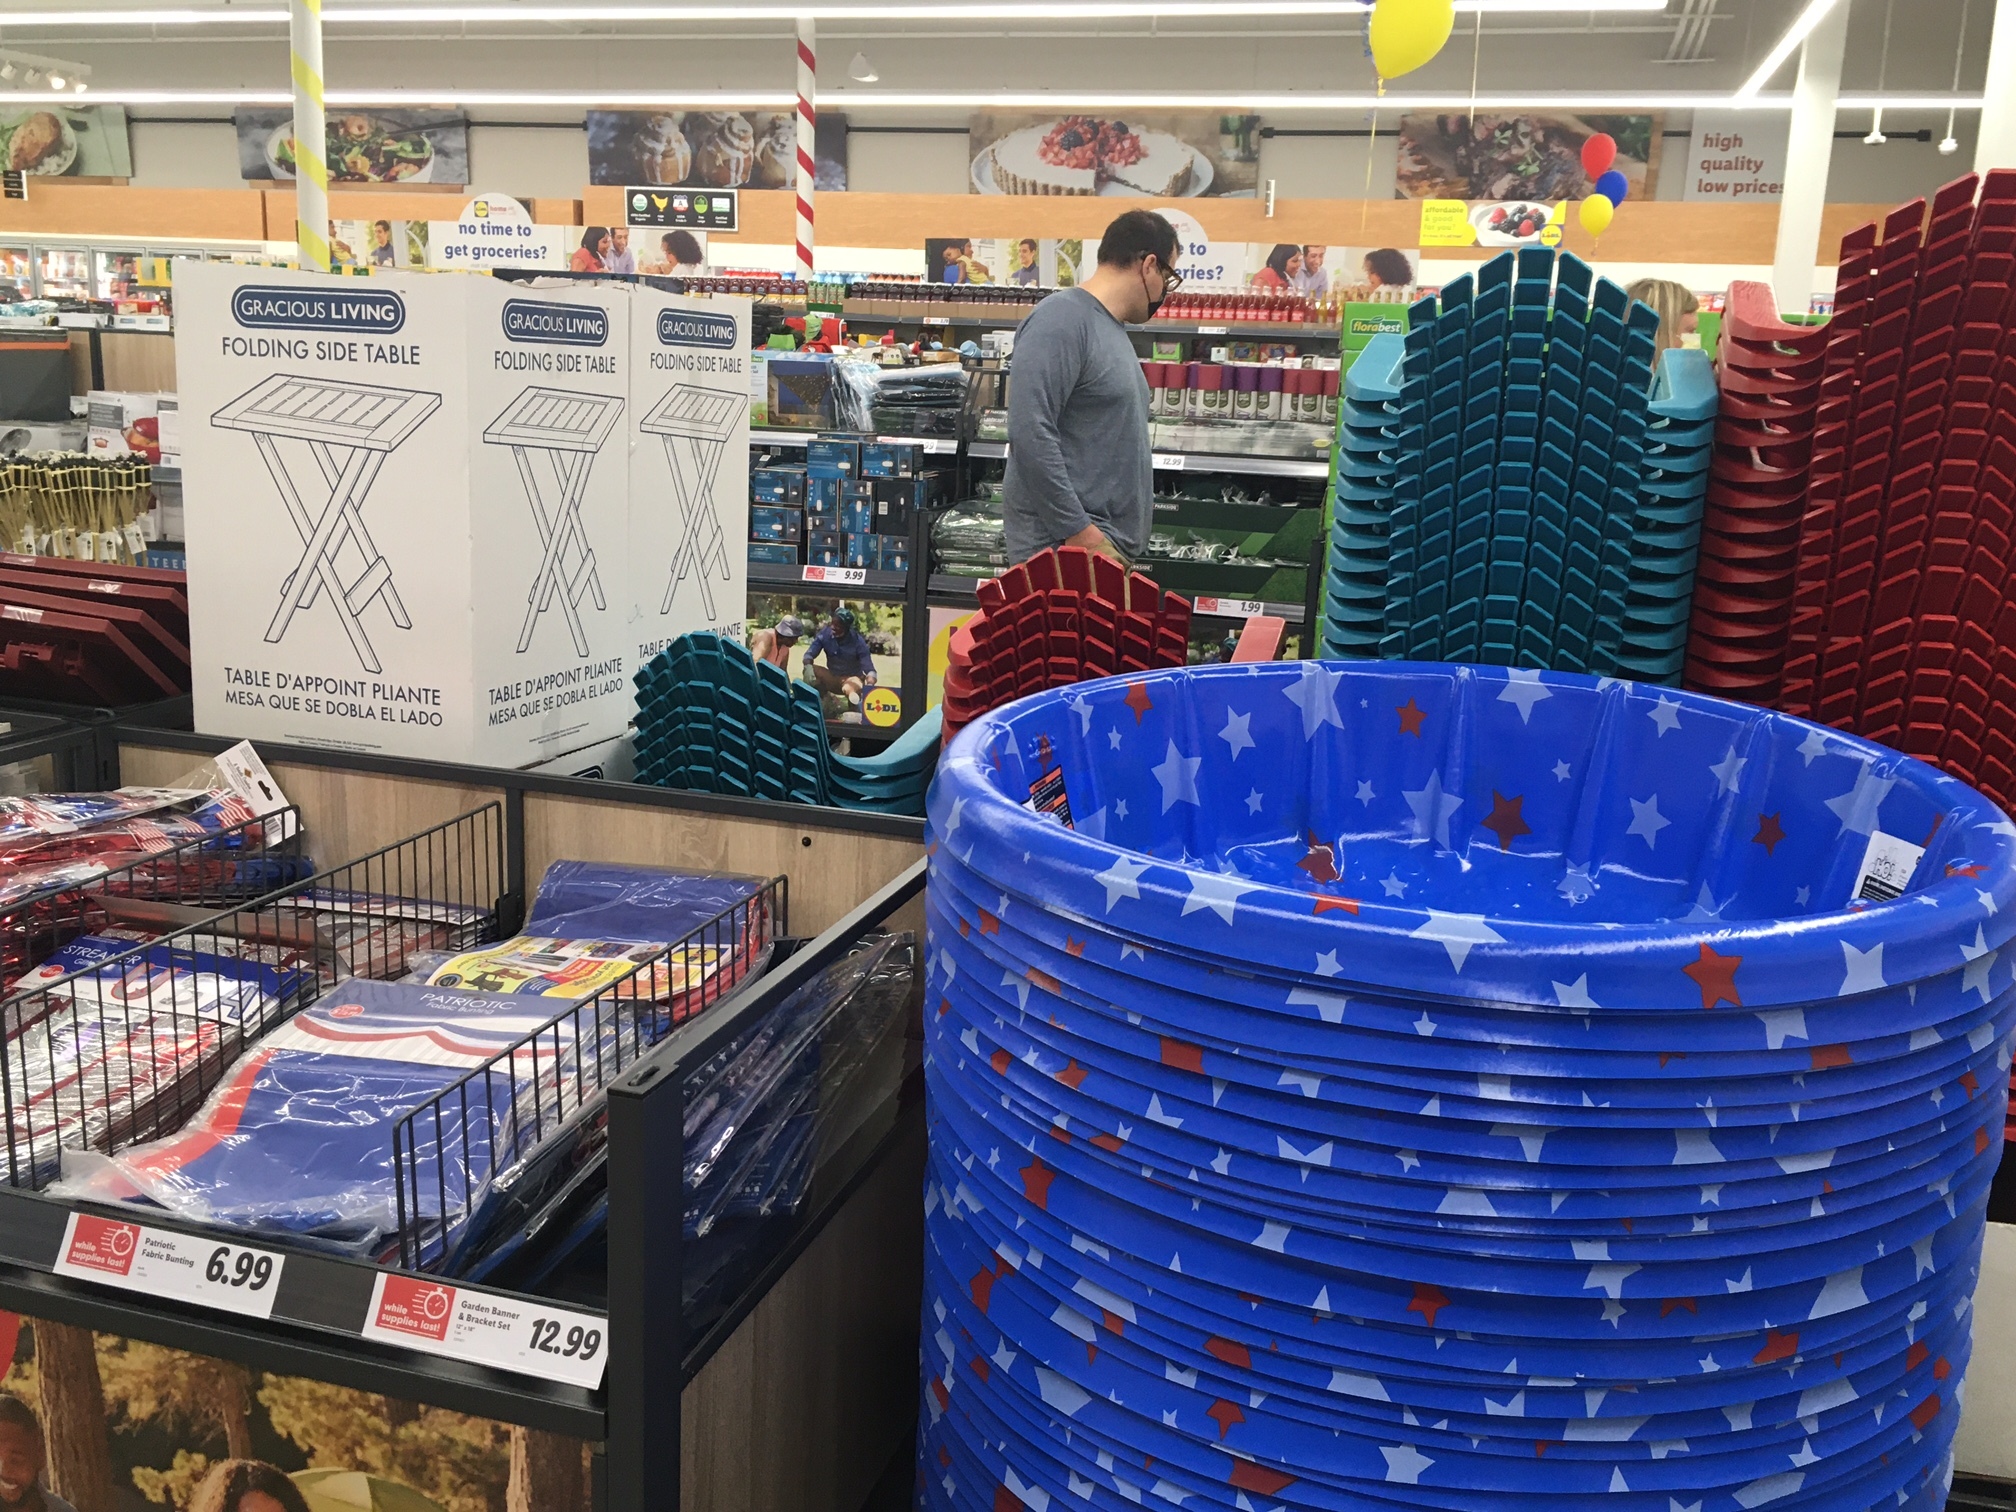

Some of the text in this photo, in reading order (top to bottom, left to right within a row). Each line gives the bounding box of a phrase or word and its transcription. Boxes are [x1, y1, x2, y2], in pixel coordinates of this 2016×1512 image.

[1702, 132, 1744, 152] high
[1700, 155, 1764, 174] quality
[1697, 178, 1784, 197] low prices
[1424, 206, 1464, 214] affordable
[458, 220, 532, 237] no time to
[444, 243, 547, 261] get groceries?
[1189, 242, 1207, 256] to
[1175, 264, 1224, 281] eries?
[241, 299, 395, 321] GRACIOUS LIVING
[508, 313, 603, 335] GRACIOUS LIVING
[661, 320, 733, 340] GRACIOUS LIVING
[1352, 320, 1401, 333] florabest
[222, 337, 420, 365] FOLDING SIDE TABLE
[494, 350, 616, 374] FOLDING SIDE TABLE
[650, 352, 694, 371] FOLDING
[697, 355, 716, 373] SIDE
[719, 356, 742, 374] TABLE
[1162, 457, 1182, 466] 12.99
[844, 570, 864, 581] 9.99
[1240, 601, 1261, 613] 1.99
[638, 639, 664, 659] TABLE
[224, 667, 441, 706] TABLE D'APPOINT PLIANTE
[488, 657, 623, 706] TABLE D'APPOINT PLIANTE
[225, 689, 443, 727] MESA QUE SE DOBLA EL LADO
[488, 677, 623, 727] MESA QUE SE DOBLA EL LADO
[62, 945, 142, 965] STREAR
[420, 993, 517, 1011] PATRIOTIC
[426, 1001, 495, 1016] Fabric Bunting
[75, 1241, 97, 1252] while
[145, 1237, 176, 1251] Patriotic
[72, 1250, 126, 1268] supplies last!
[141, 1249, 195, 1268] Fabric Bunting
[206, 1246, 273, 1291] 6.99
[384, 1303, 408, 1315] while
[461, 1300, 521, 1320] Garden Banner
[381, 1313, 441, 1332] supplies last!
[458, 1312, 511, 1331] & Bracket Set
[529, 1318, 601, 1361] 12.99
